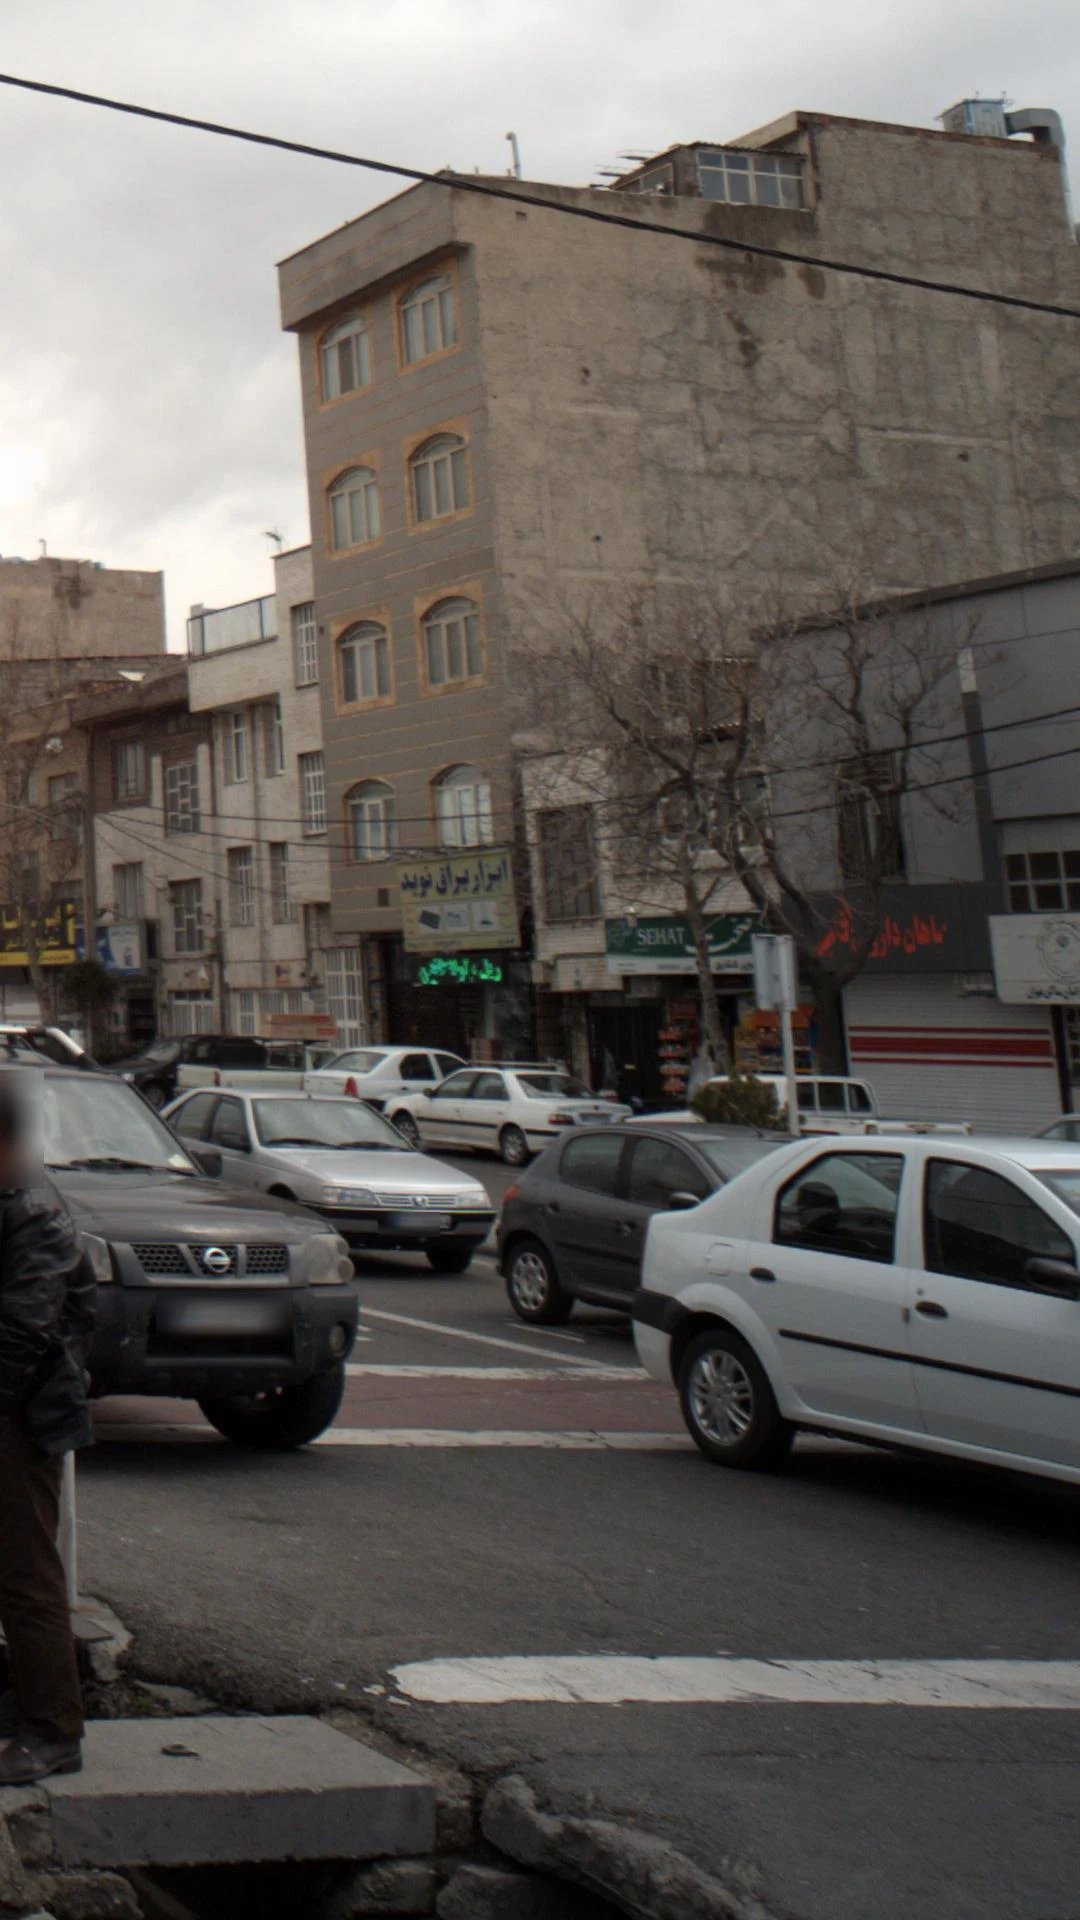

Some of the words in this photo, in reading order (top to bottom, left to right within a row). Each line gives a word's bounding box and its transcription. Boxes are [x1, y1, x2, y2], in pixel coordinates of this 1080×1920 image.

[400, 865, 432, 898] نوید
[471, 856, 508, 893] ابزار
[637, 926, 685, 946] SEHAT
